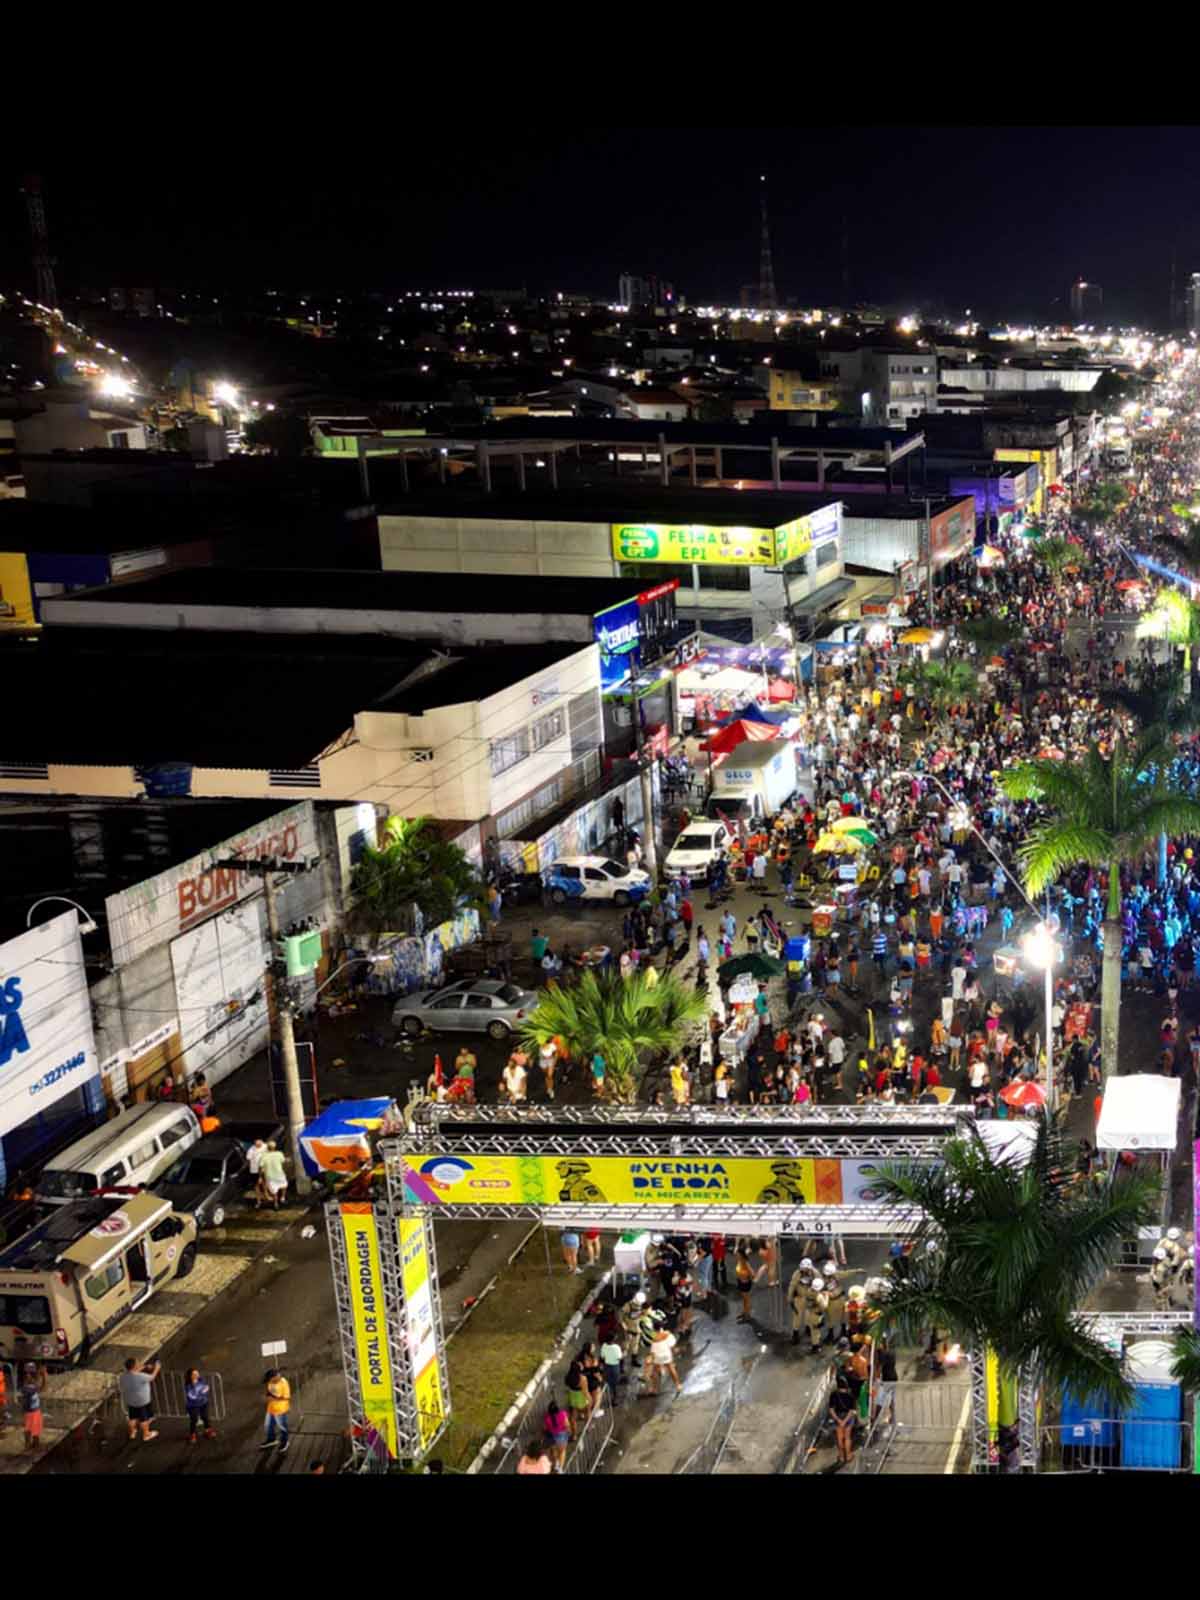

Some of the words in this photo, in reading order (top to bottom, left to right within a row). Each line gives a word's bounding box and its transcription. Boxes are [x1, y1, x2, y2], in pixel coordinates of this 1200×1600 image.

[681, 550, 707, 560] EPI
[630, 1163, 726, 1174] #VENHA
[633, 1177, 664, 1189] DE
[671, 1177, 729, 1189] BOA!
[657, 1191, 730, 1199] MICARETA
[815, 1223, 832, 1232] 01
[355, 1231, 376, 1313] ABORDAGEM
[364, 1316, 378, 1332] DE
[366, 1336, 384, 1385] PORTAL
